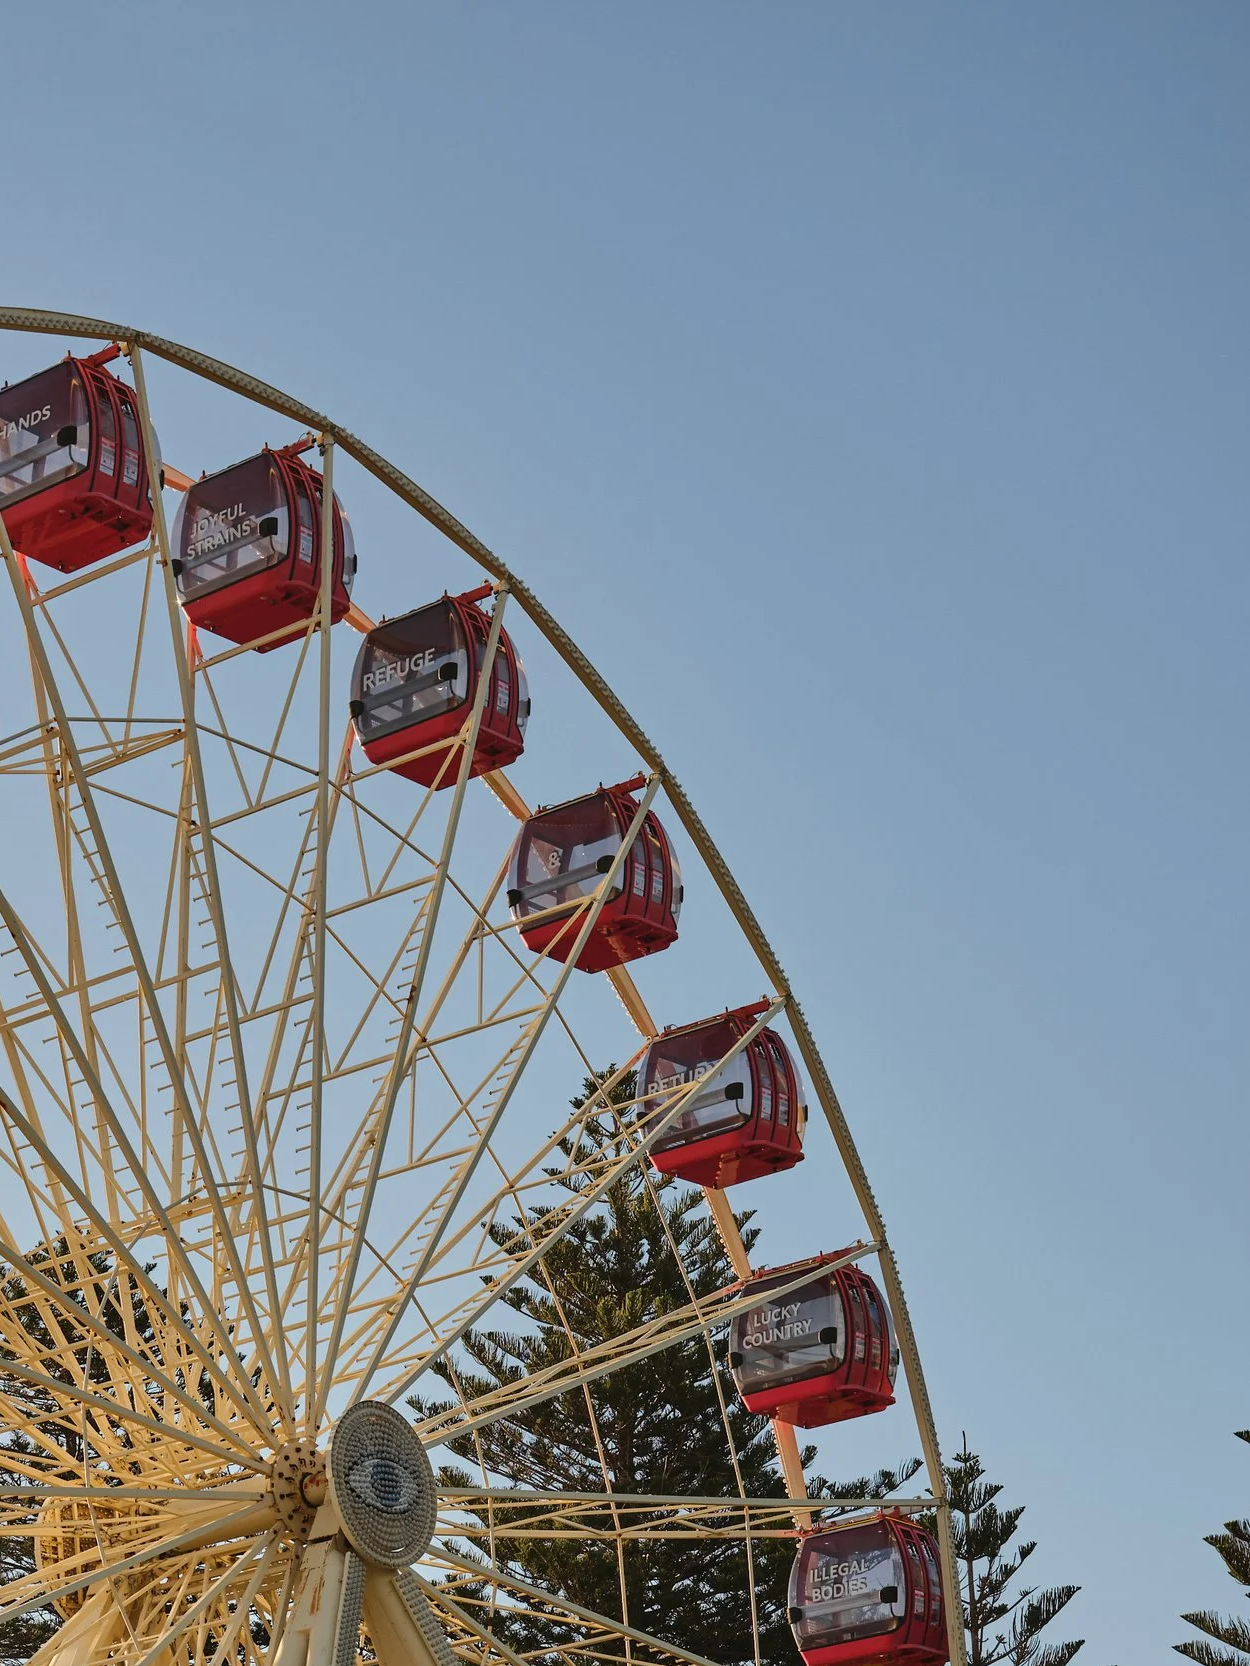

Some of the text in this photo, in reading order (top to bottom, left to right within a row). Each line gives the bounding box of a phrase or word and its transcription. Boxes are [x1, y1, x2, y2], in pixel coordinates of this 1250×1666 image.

[190, 502, 246, 538] JOYFUL
[187, 520, 250, 560] STRAINS
[363, 647, 436, 692] REFUGE
[754, 1302, 801, 1327] LUCKY
[742, 1318, 812, 1349] COUNTRY
[810, 1559, 868, 1583] ILLEGAL
[812, 1577, 867, 1602] BODIES
